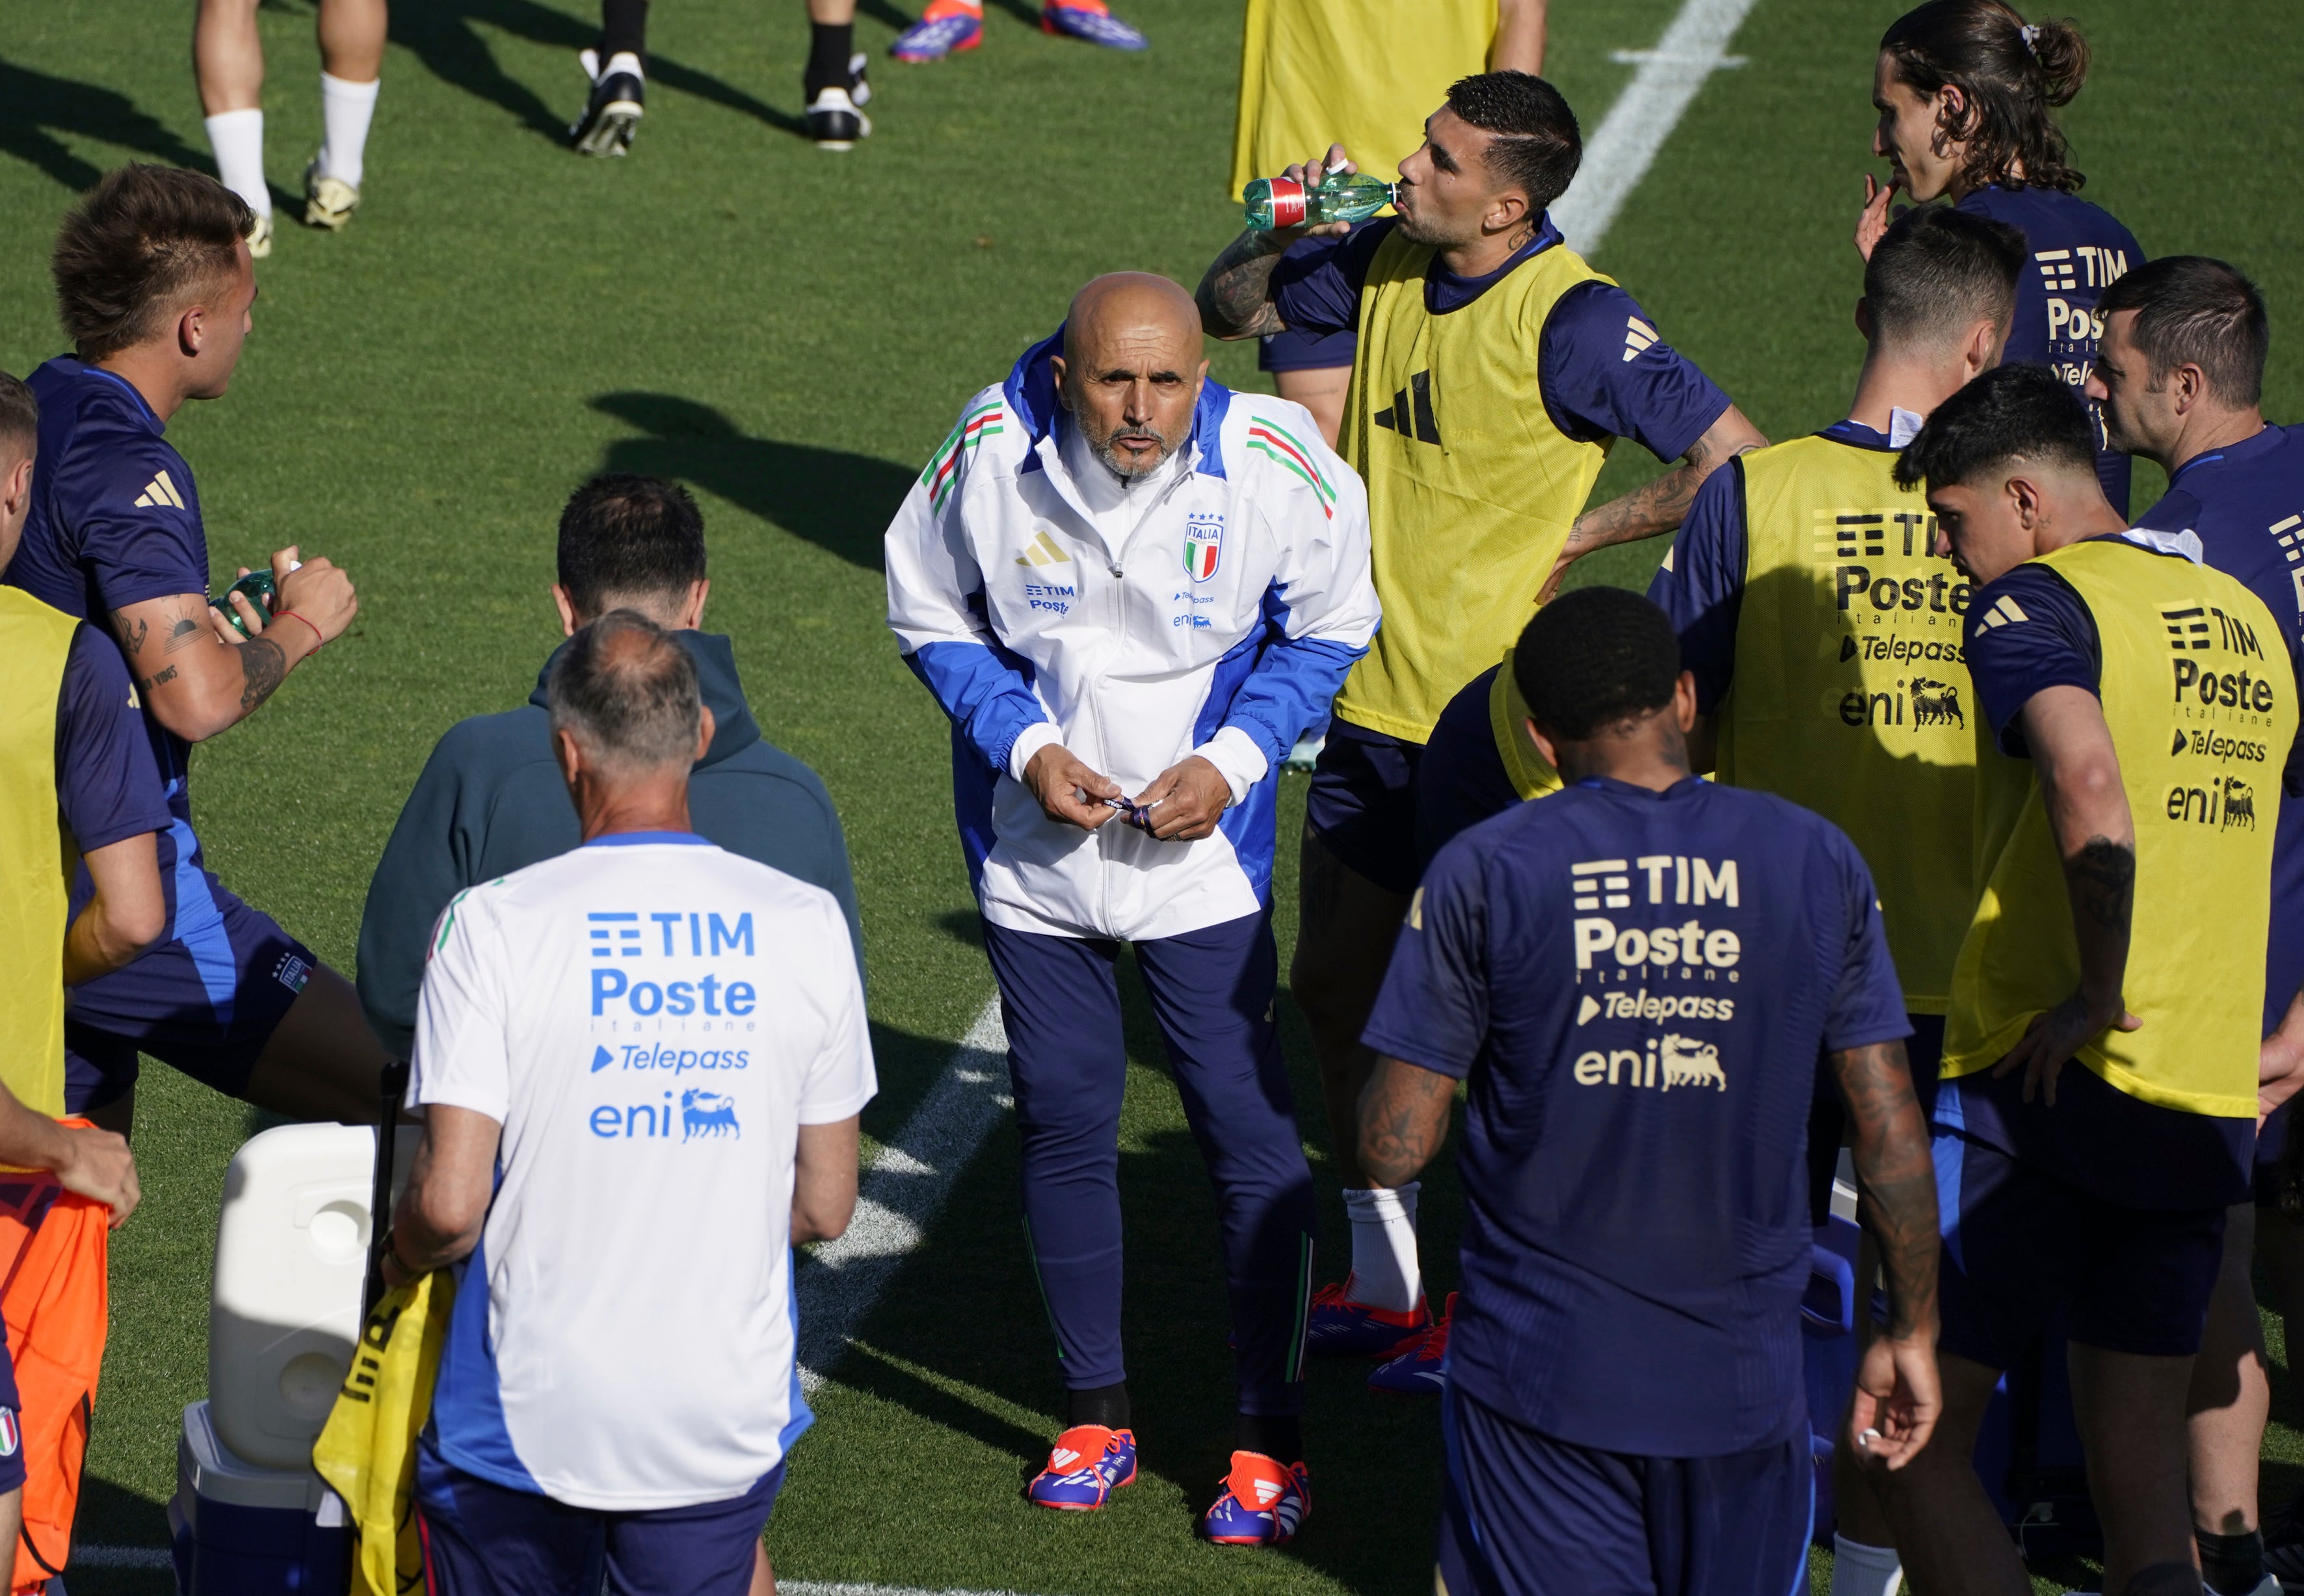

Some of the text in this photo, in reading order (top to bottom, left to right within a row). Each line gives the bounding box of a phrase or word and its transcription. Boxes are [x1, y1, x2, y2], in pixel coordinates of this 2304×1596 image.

[2076, 246, 2128, 287] TIM
[2047, 298, 2109, 340] Pos
[2048, 339, 2099, 353] itali
[1188, 525, 1219, 540] ITALIA
[1894, 512, 1950, 559] TI
[1029, 600, 1069, 615] Poste
[1043, 586, 1075, 597] TIM
[1836, 565, 1972, 616] Poste
[1173, 613, 1192, 627] eni
[1837, 611, 1956, 628] italian
[2210, 607, 2264, 661] TIM
[1839, 679, 1905, 726] eni
[2173, 658, 2273, 713] Poste
[2173, 704, 2272, 728] italiane
[2190, 728, 2267, 764] Telepass
[2167, 777, 2220, 825] eni
[1637, 855, 1739, 907] TIM
[650, 912, 754, 957] TIM
[1574, 918, 1741, 969] Poste
[282, 960, 302, 985] ITALIA
[590, 968, 756, 1017] Poste
[1576, 964, 1740, 985] italiane
[590, 1018, 756, 1032] italiane
[1604, 988, 1734, 1026] Telepass
[620, 1042, 750, 1076] Telepass
[1574, 1039, 1658, 1088] eni
[589, 1091, 672, 1138] eni
